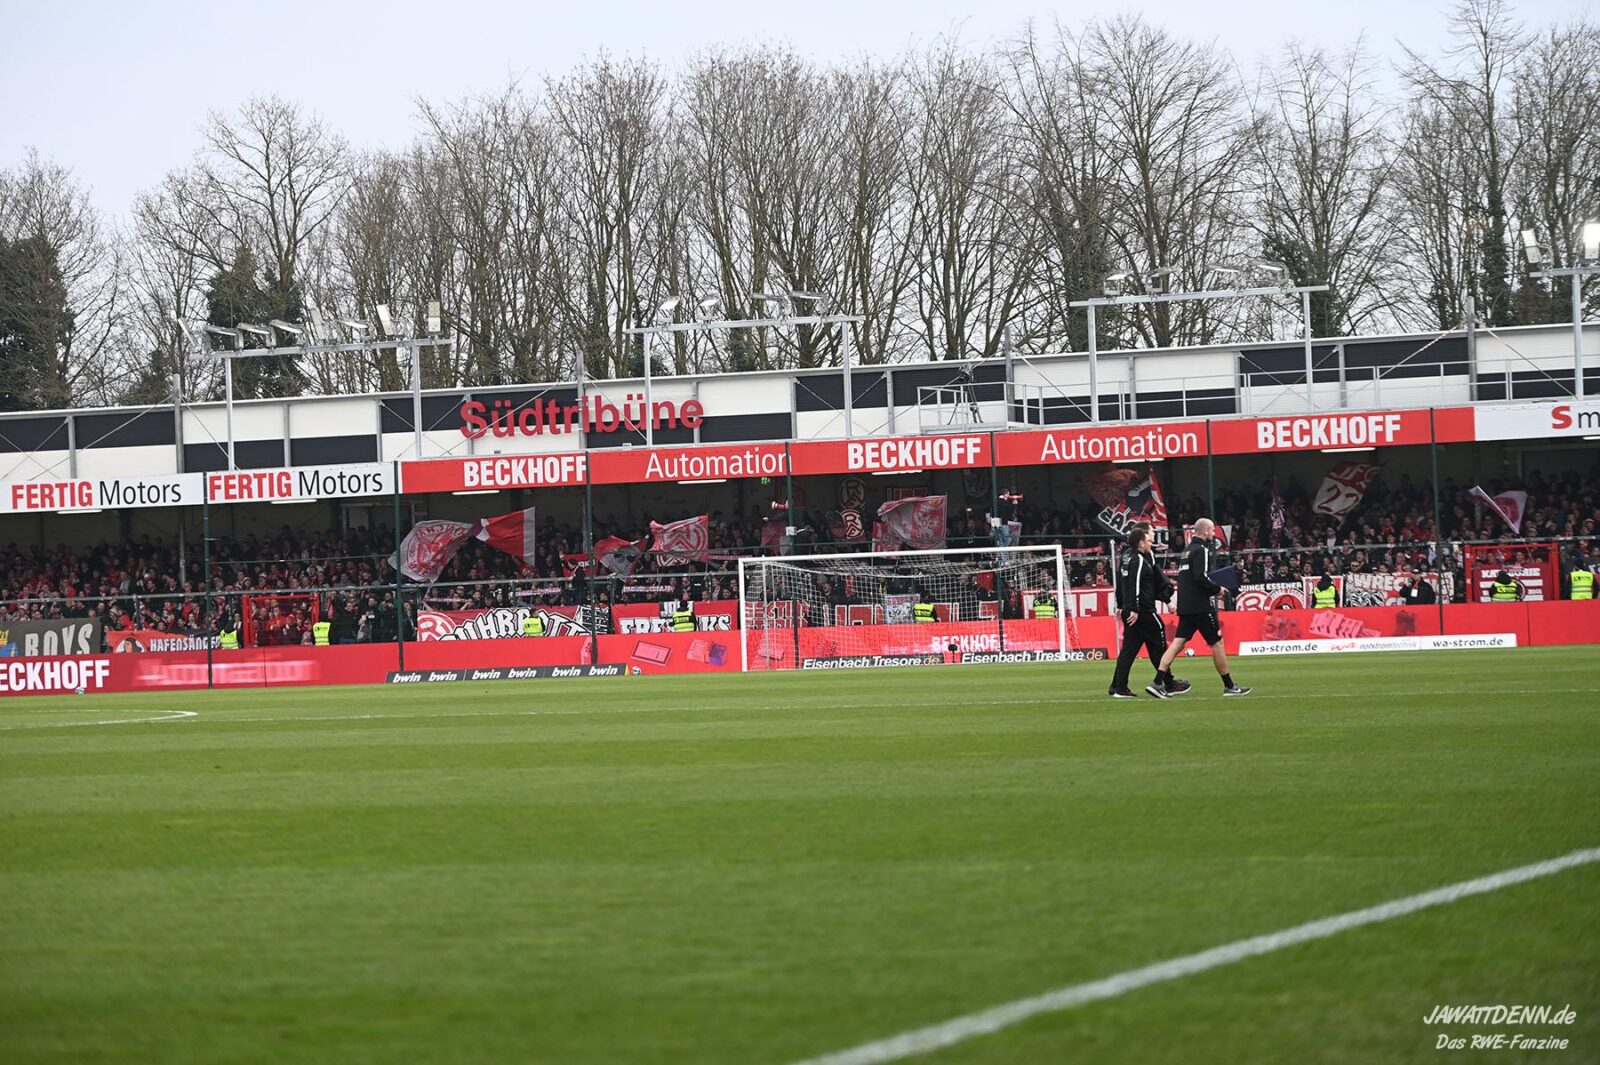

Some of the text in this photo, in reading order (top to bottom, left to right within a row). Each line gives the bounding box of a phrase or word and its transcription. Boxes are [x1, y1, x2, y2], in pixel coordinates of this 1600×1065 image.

[459, 393, 705, 440] Südtribüne
[1257, 415, 1401, 449] BECKHOFF
[1041, 427, 1198, 461] Automation
[848, 437, 982, 470] BECKHOFF
[645, 447, 792, 479] Automation
[464, 455, 587, 487] BECKHOFF
[208, 470, 384, 500] FERTIG Motors
[11, 480, 182, 510] FERTIG Motors
[1238, 583, 1266, 592] JUNGE
[25, 622, 94, 657] BOYS
[1432, 636, 1504, 648] wa-strom.de
[1250, 642, 1319, 653] wa-strom.de
[803, 654, 940, 669] Eisenbach Tresore.de
[961, 651, 1033, 664] Eisenbach
[428, 670, 458, 683] bwin
[471, 669, 501, 681] bwin
[508, 667, 537, 680] bwin
[551, 665, 581, 678] bwin
[588, 664, 618, 676] bwin
[392, 672, 422, 684] bwin
